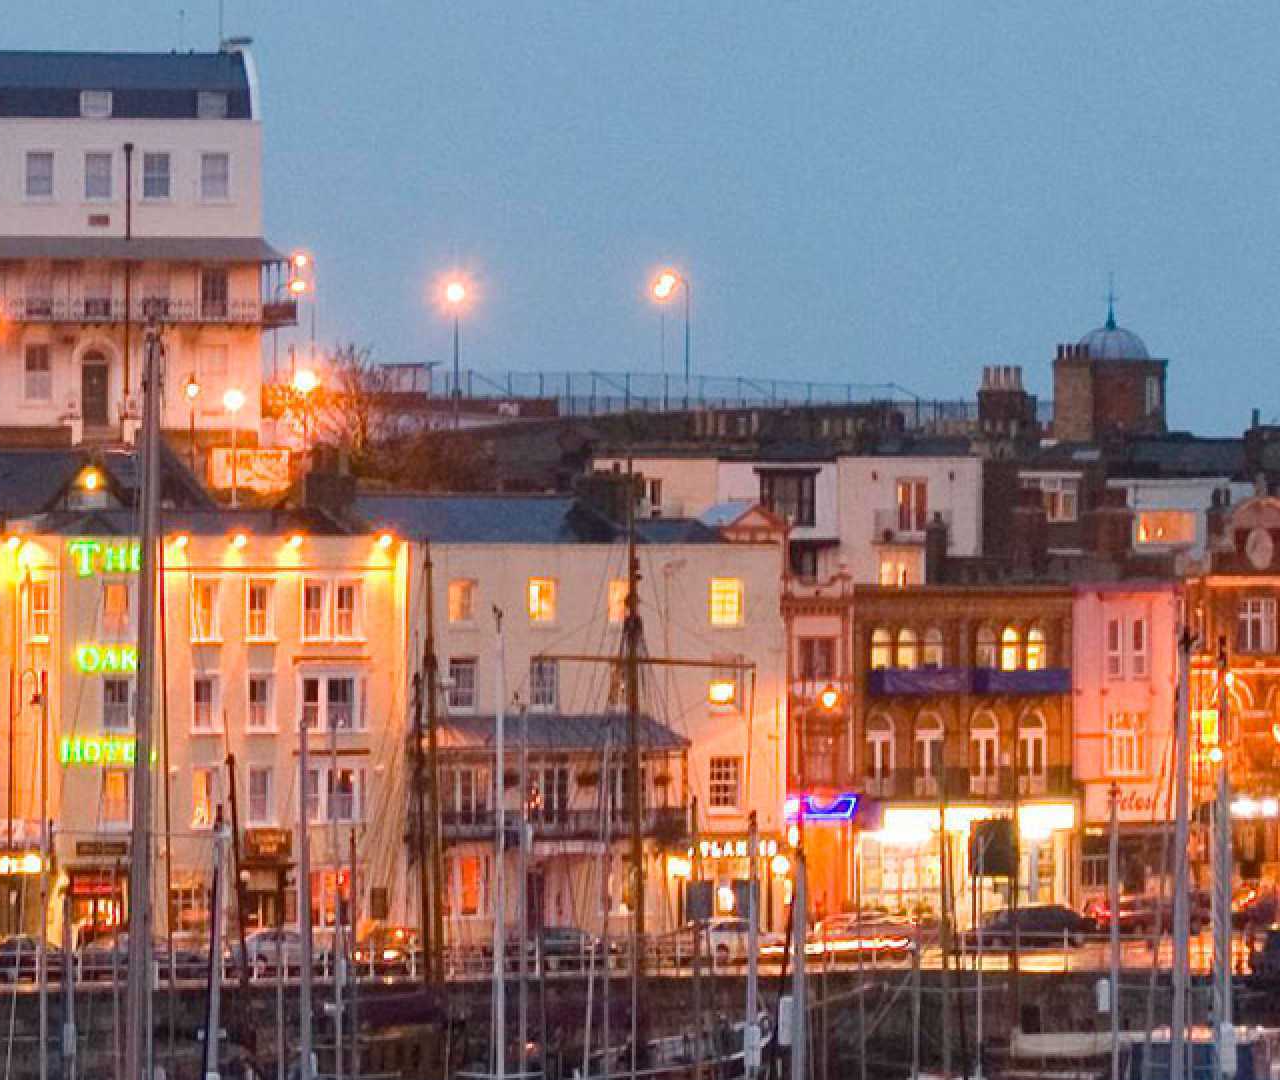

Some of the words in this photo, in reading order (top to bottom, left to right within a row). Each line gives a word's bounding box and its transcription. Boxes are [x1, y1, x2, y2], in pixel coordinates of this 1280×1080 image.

[77, 645, 138, 673] OAK
[59, 736, 158, 766] HOTE
[687, 839, 778, 858] TLANIS
